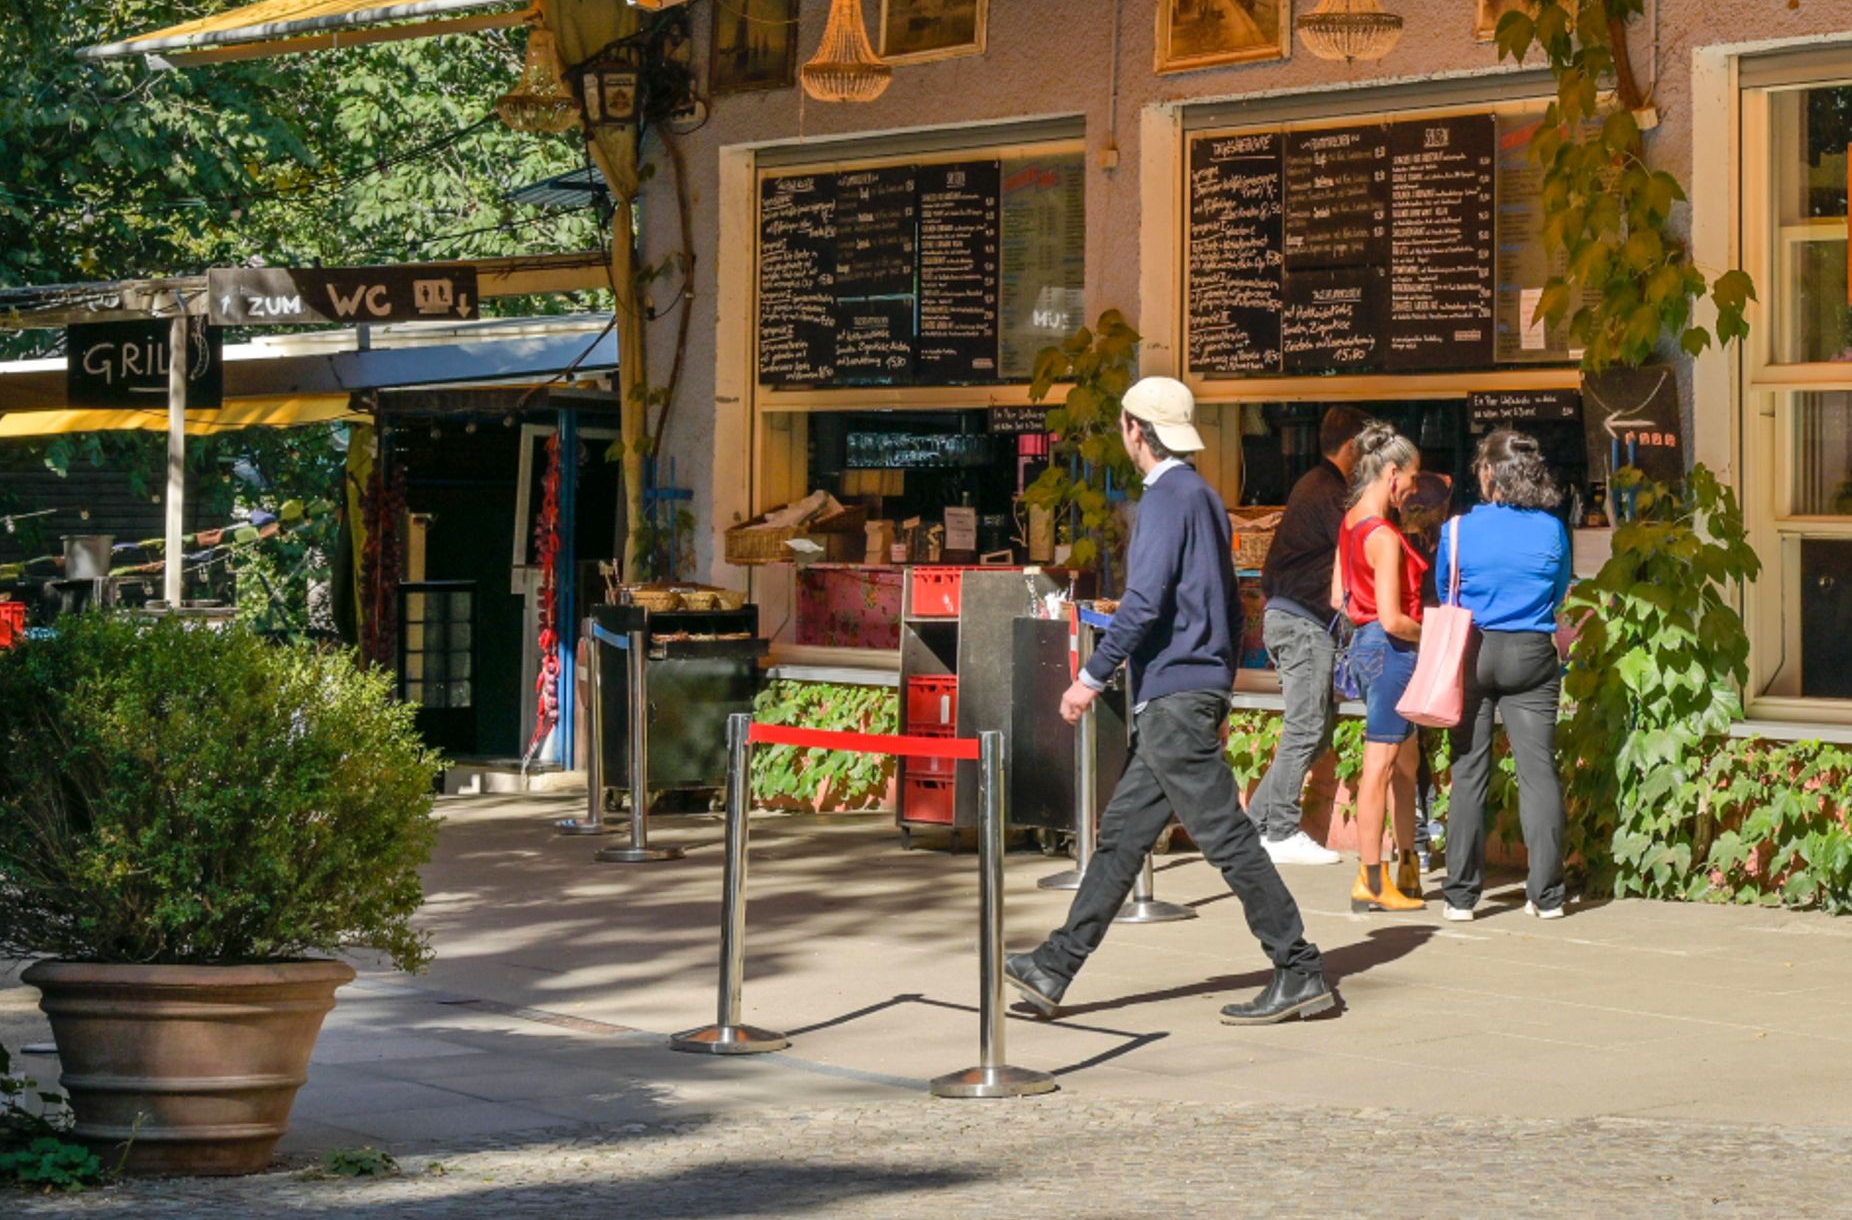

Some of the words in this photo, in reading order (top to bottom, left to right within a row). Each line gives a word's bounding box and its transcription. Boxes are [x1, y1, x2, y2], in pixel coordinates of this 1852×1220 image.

[248, 293, 302, 317] ZUM
[326, 283, 392, 317] WC
[82, 334, 170, 385] GRIL
